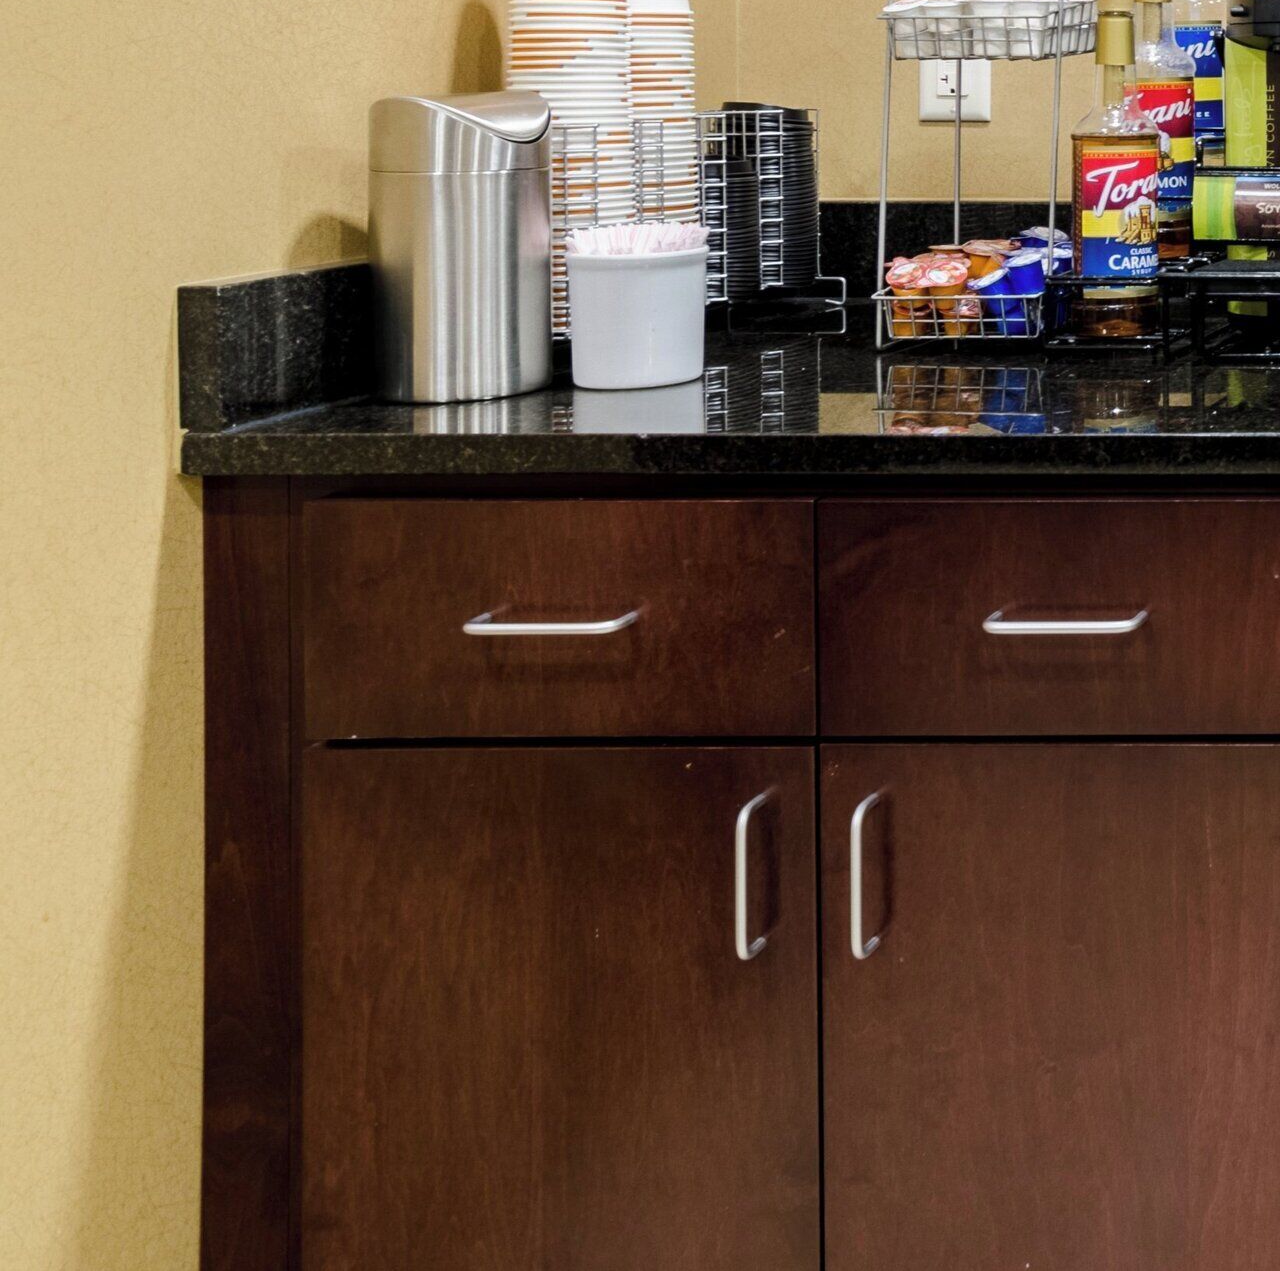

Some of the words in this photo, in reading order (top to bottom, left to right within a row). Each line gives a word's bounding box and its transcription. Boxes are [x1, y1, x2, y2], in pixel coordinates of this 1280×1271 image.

[1085, 160, 1159, 217] Tora
[1129, 247, 1153, 255] CLASSIC
[1108, 254, 1159, 270] CARAME
